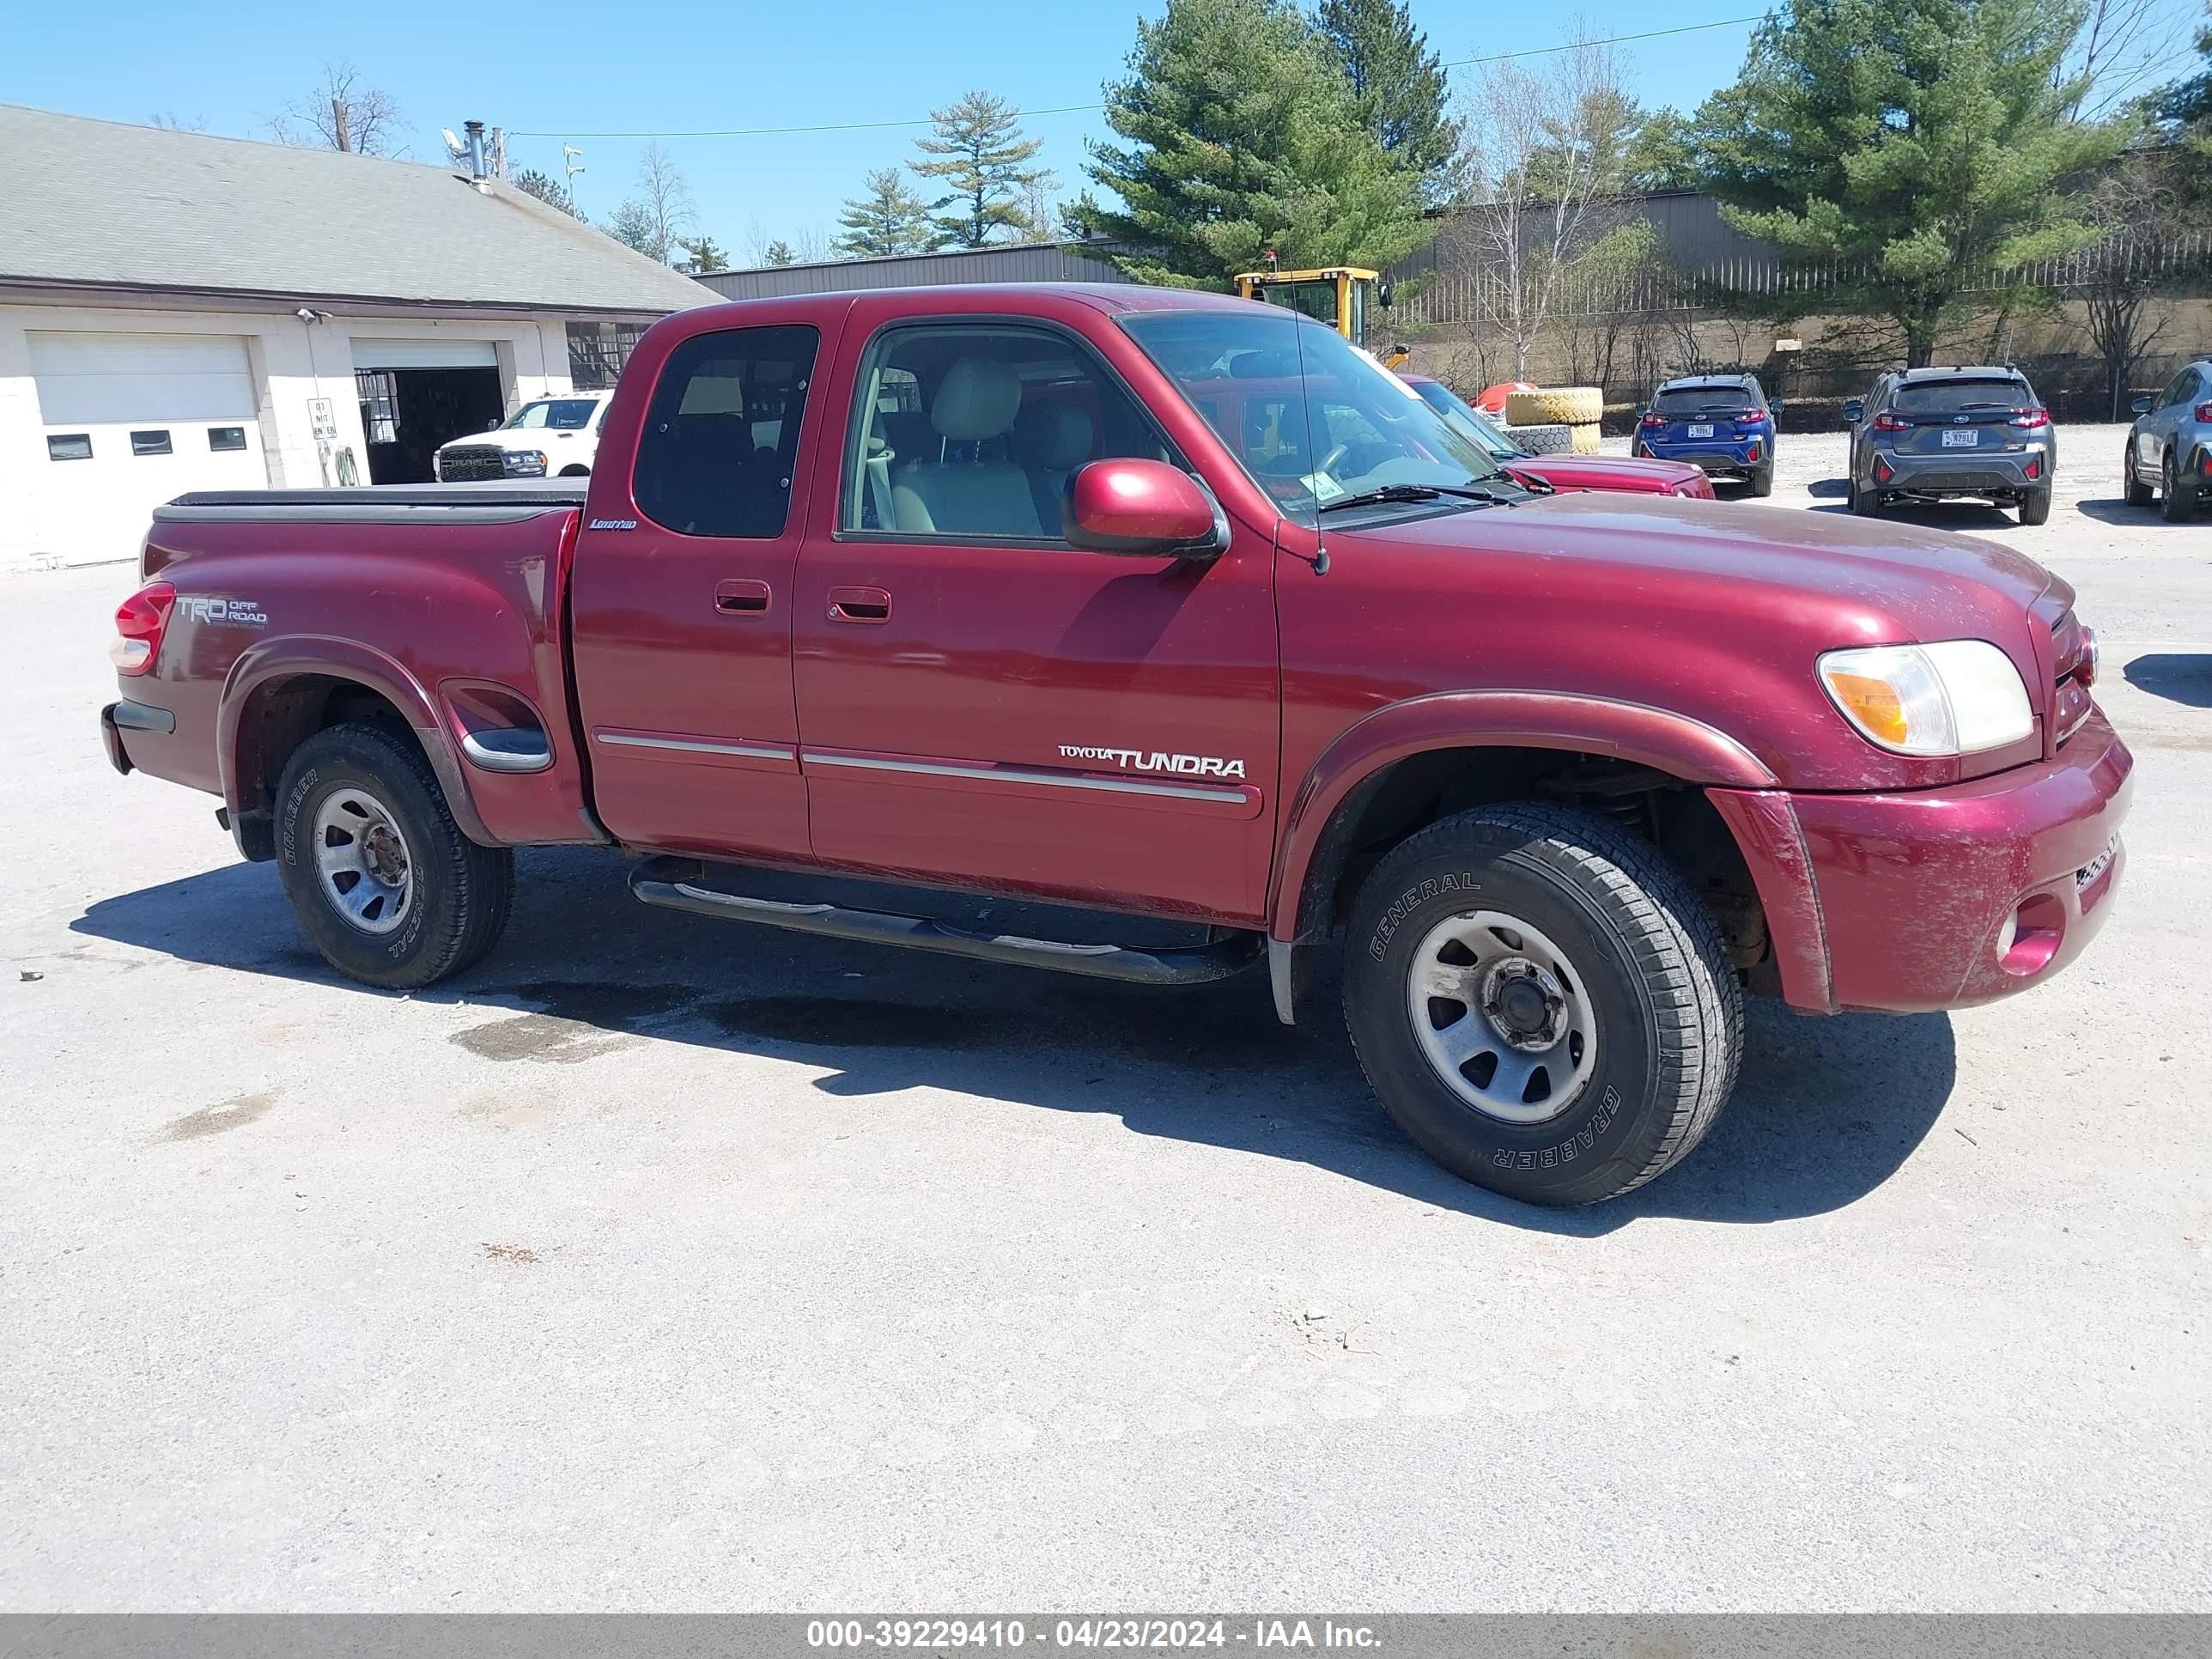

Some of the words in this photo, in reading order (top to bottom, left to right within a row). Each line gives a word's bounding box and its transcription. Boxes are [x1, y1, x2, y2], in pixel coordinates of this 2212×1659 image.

[314, 426, 335, 435] ENER
[176, 597, 228, 624] TRD
[229, 601, 258, 611] OFF
[228, 611, 267, 623] ROAD
[1058, 745, 1114, 761] TOYOTA
[1110, 749, 1247, 779] TUNDRA
[284, 769, 318, 866] GRABBER
[388, 864, 425, 959] GENERAL
[1369, 872, 1481, 962] GENERAL
[1492, 1085, 1622, 1170] GRABBER
